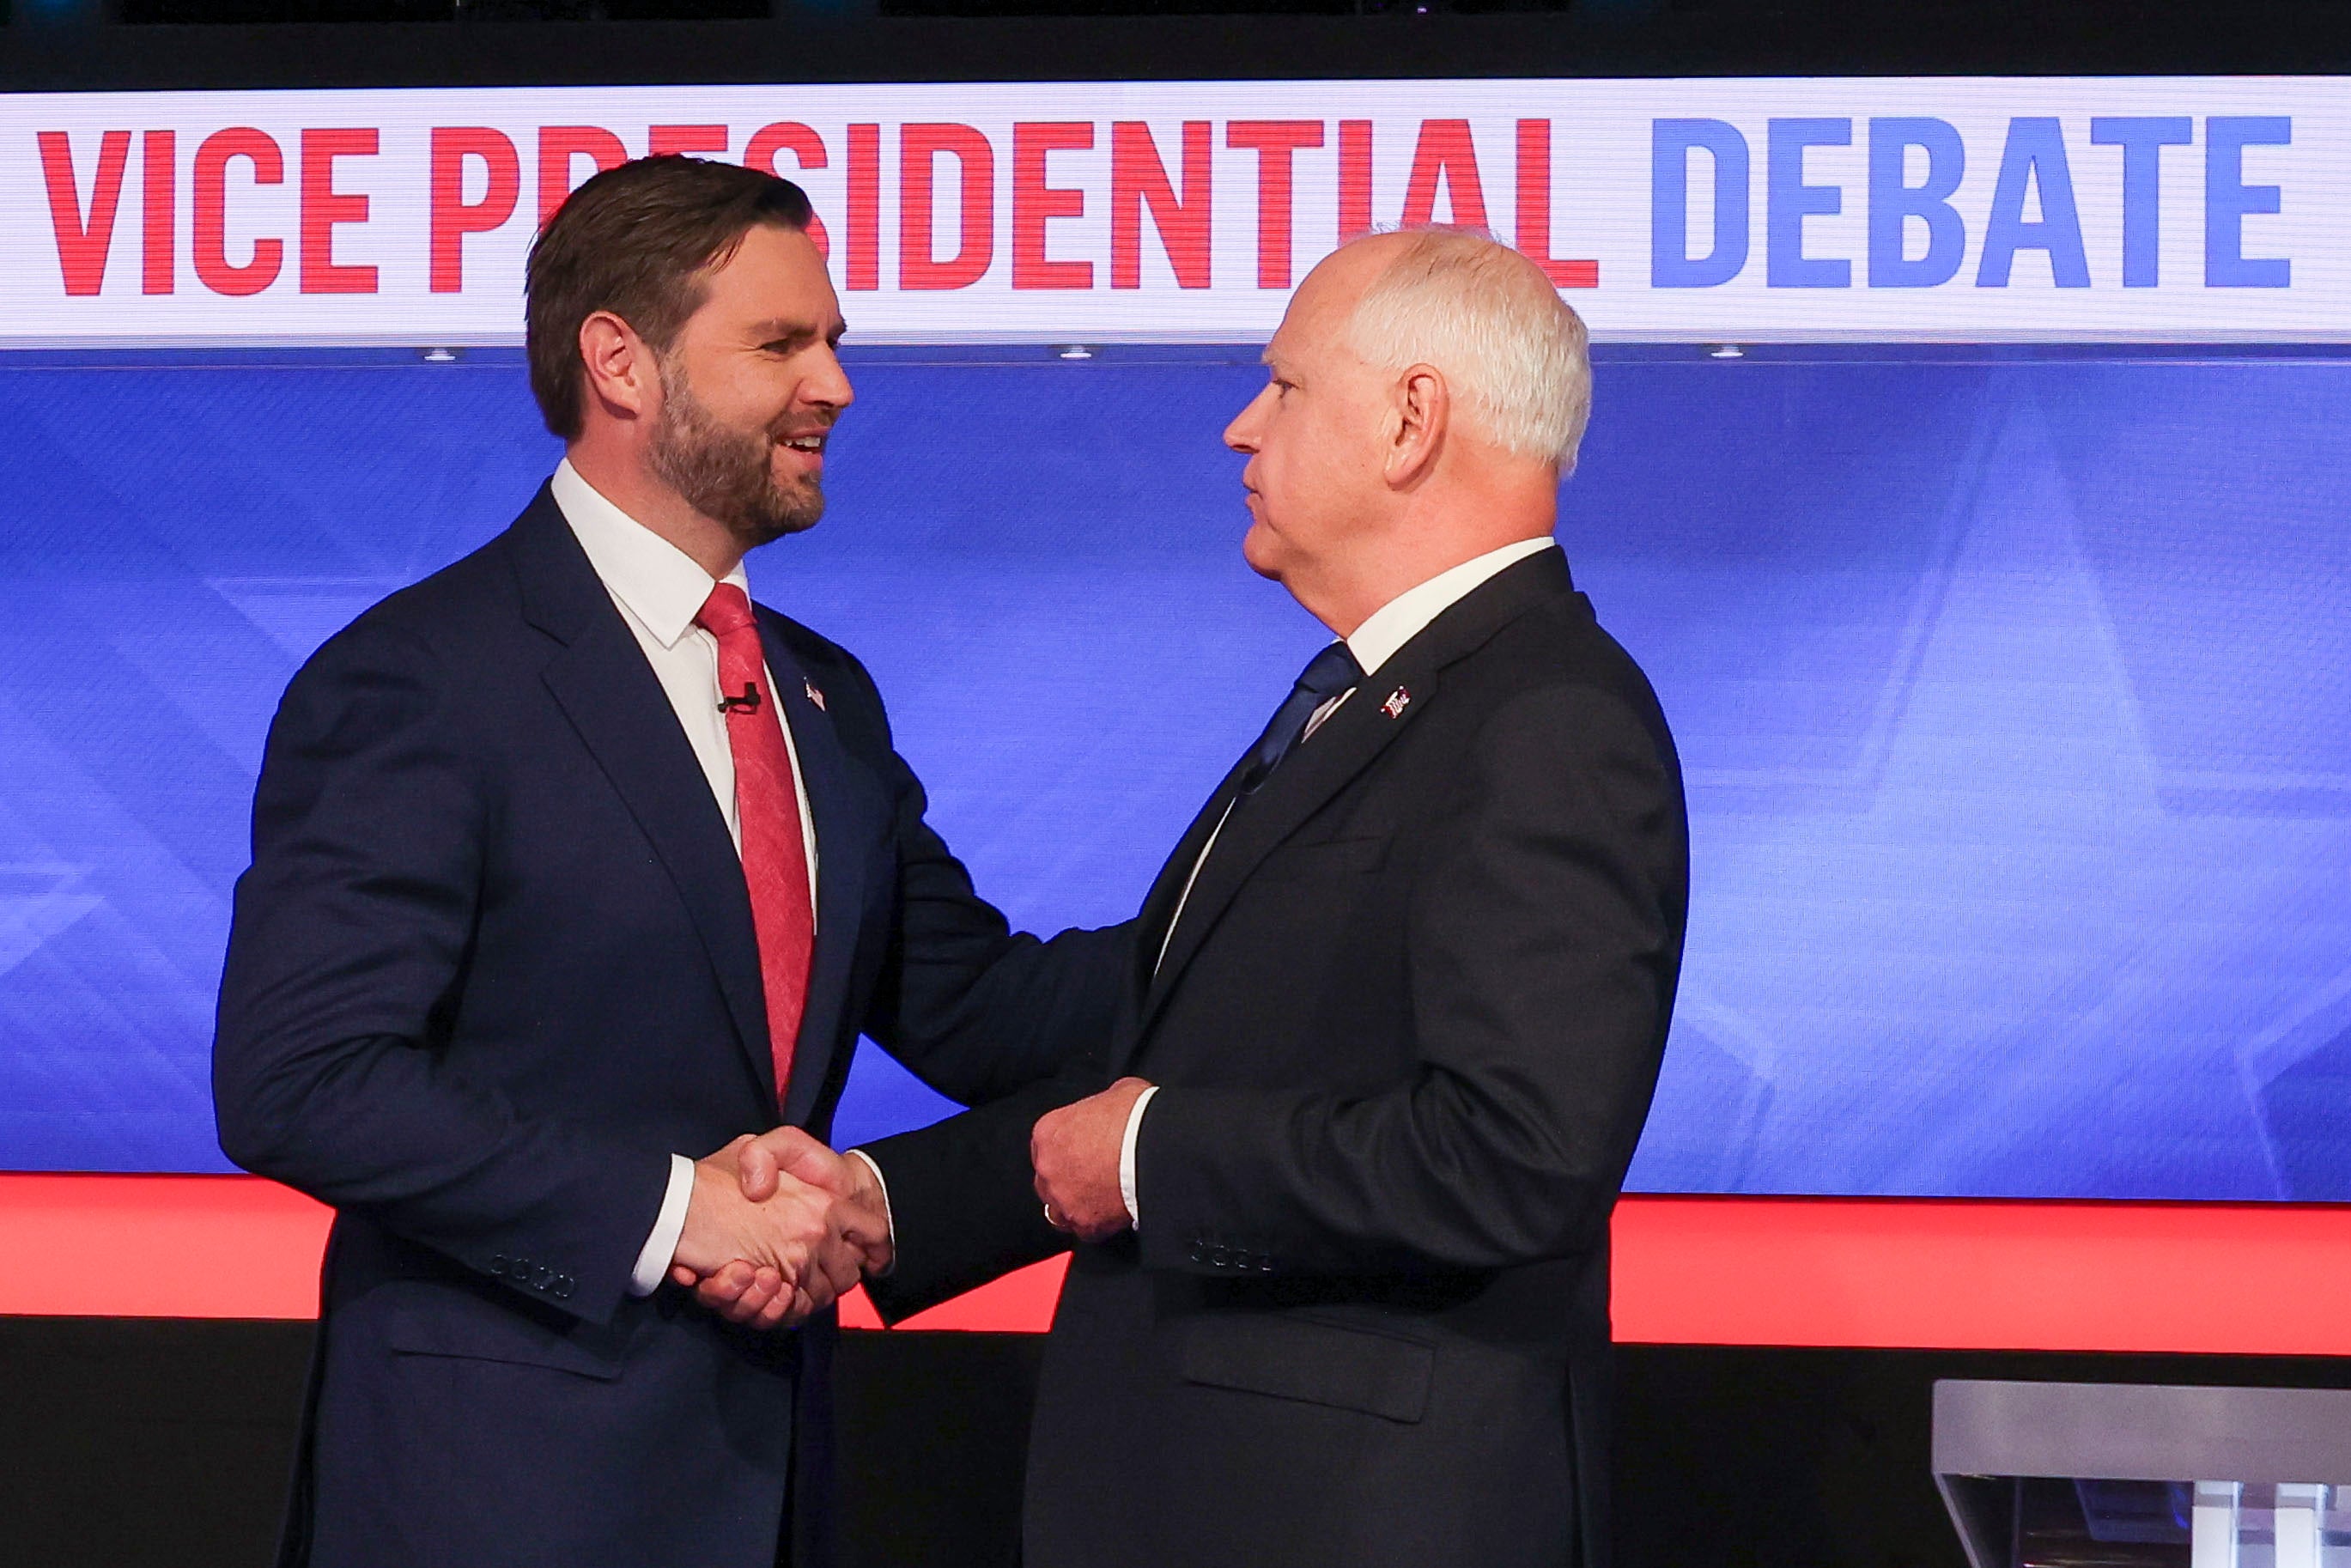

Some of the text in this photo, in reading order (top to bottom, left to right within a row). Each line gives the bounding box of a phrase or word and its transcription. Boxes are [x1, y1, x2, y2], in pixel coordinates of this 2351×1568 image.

[37, 115, 2292, 296] VICE PIDENTIAL DEBATE
